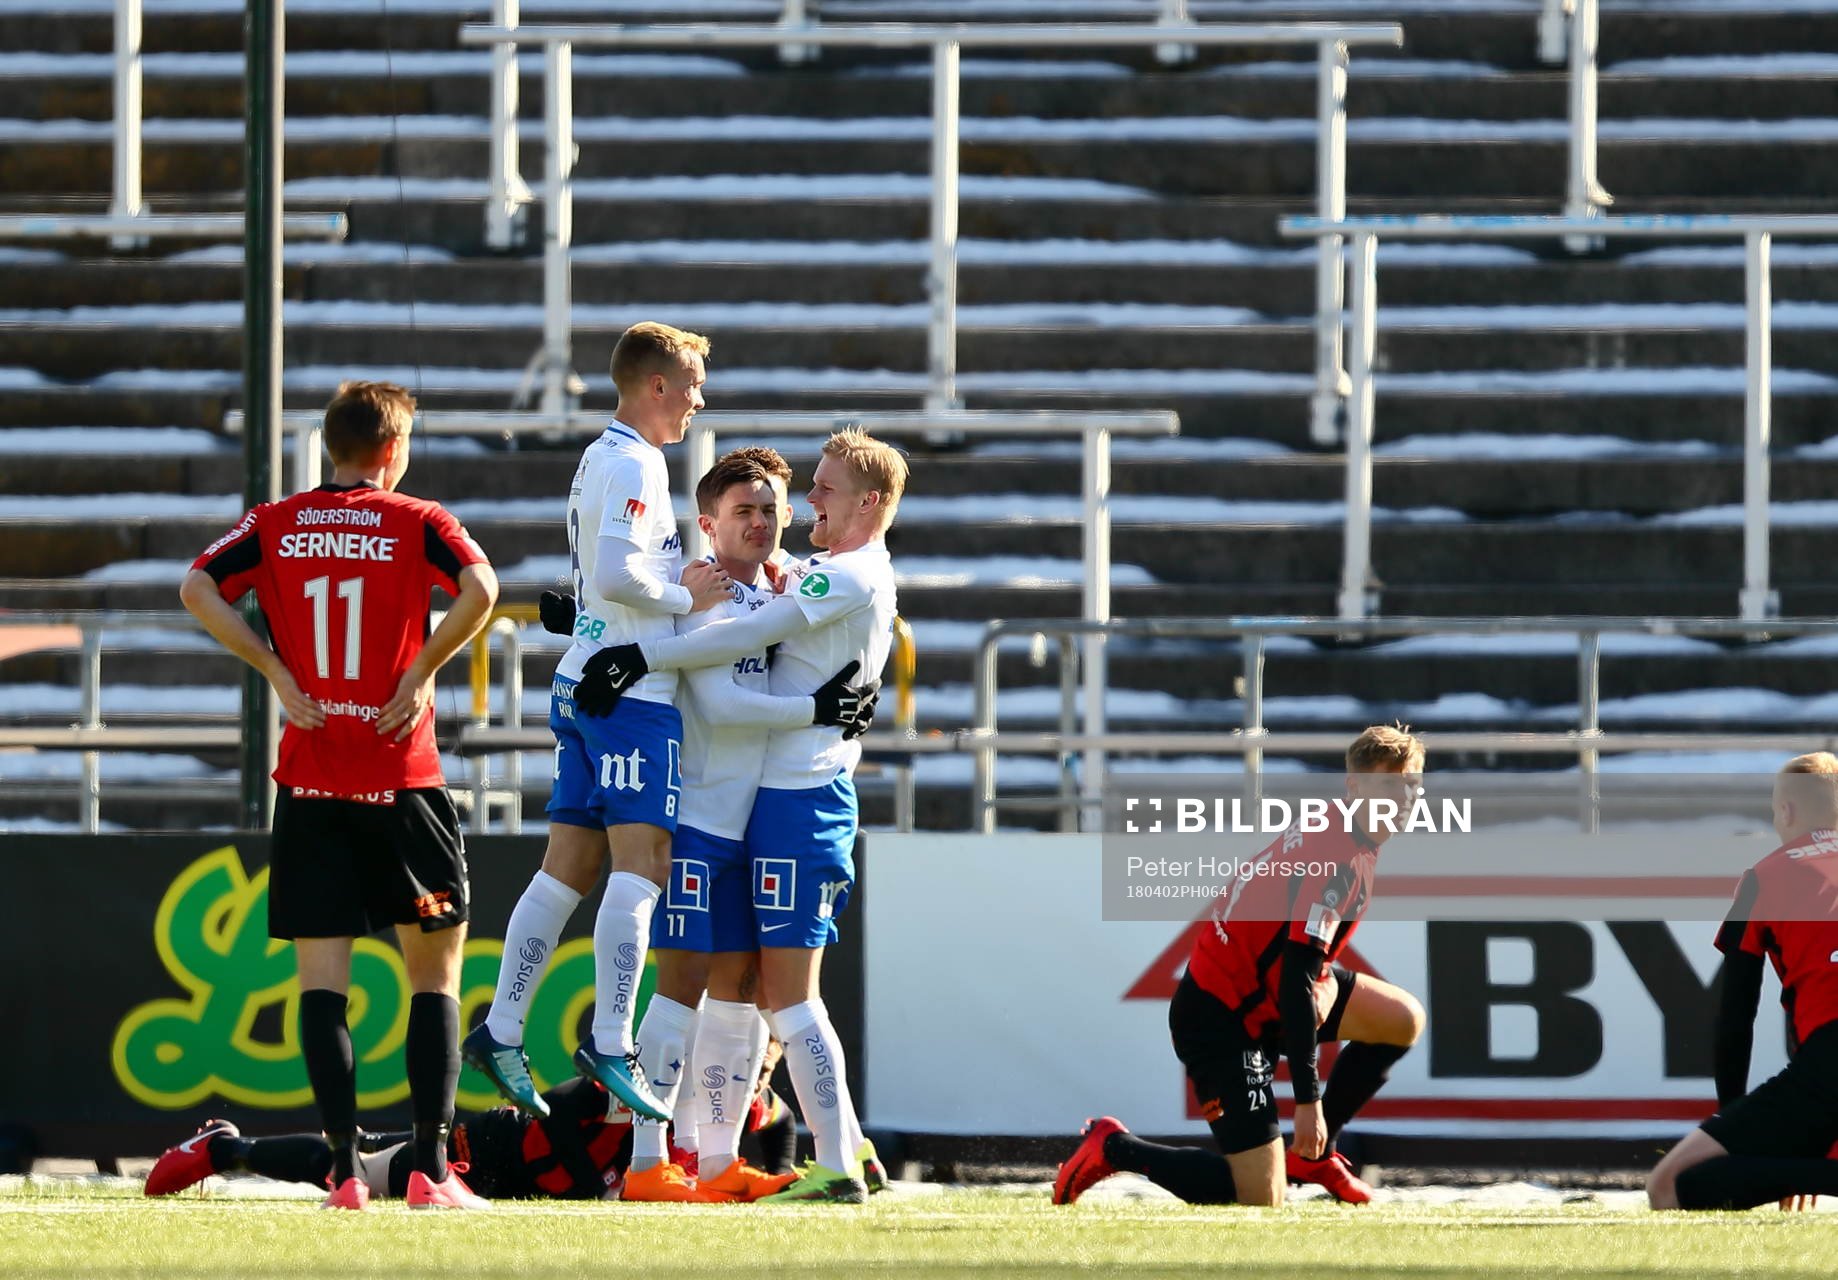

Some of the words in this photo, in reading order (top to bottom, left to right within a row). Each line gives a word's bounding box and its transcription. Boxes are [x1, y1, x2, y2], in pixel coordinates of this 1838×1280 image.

[296, 507, 382, 528] SÖDERSTRÖM
[278, 532, 394, 562] SERNEKE
[304, 575, 365, 680] 11
[600, 748, 647, 793] nt
[665, 793, 677, 818] 8
[666, 913, 685, 937] 11
[508, 961, 534, 1002] suez
[613, 972, 632, 1014] suez
[1427, 917, 1795, 1079] BY
[1247, 1088, 1267, 1112] 24
